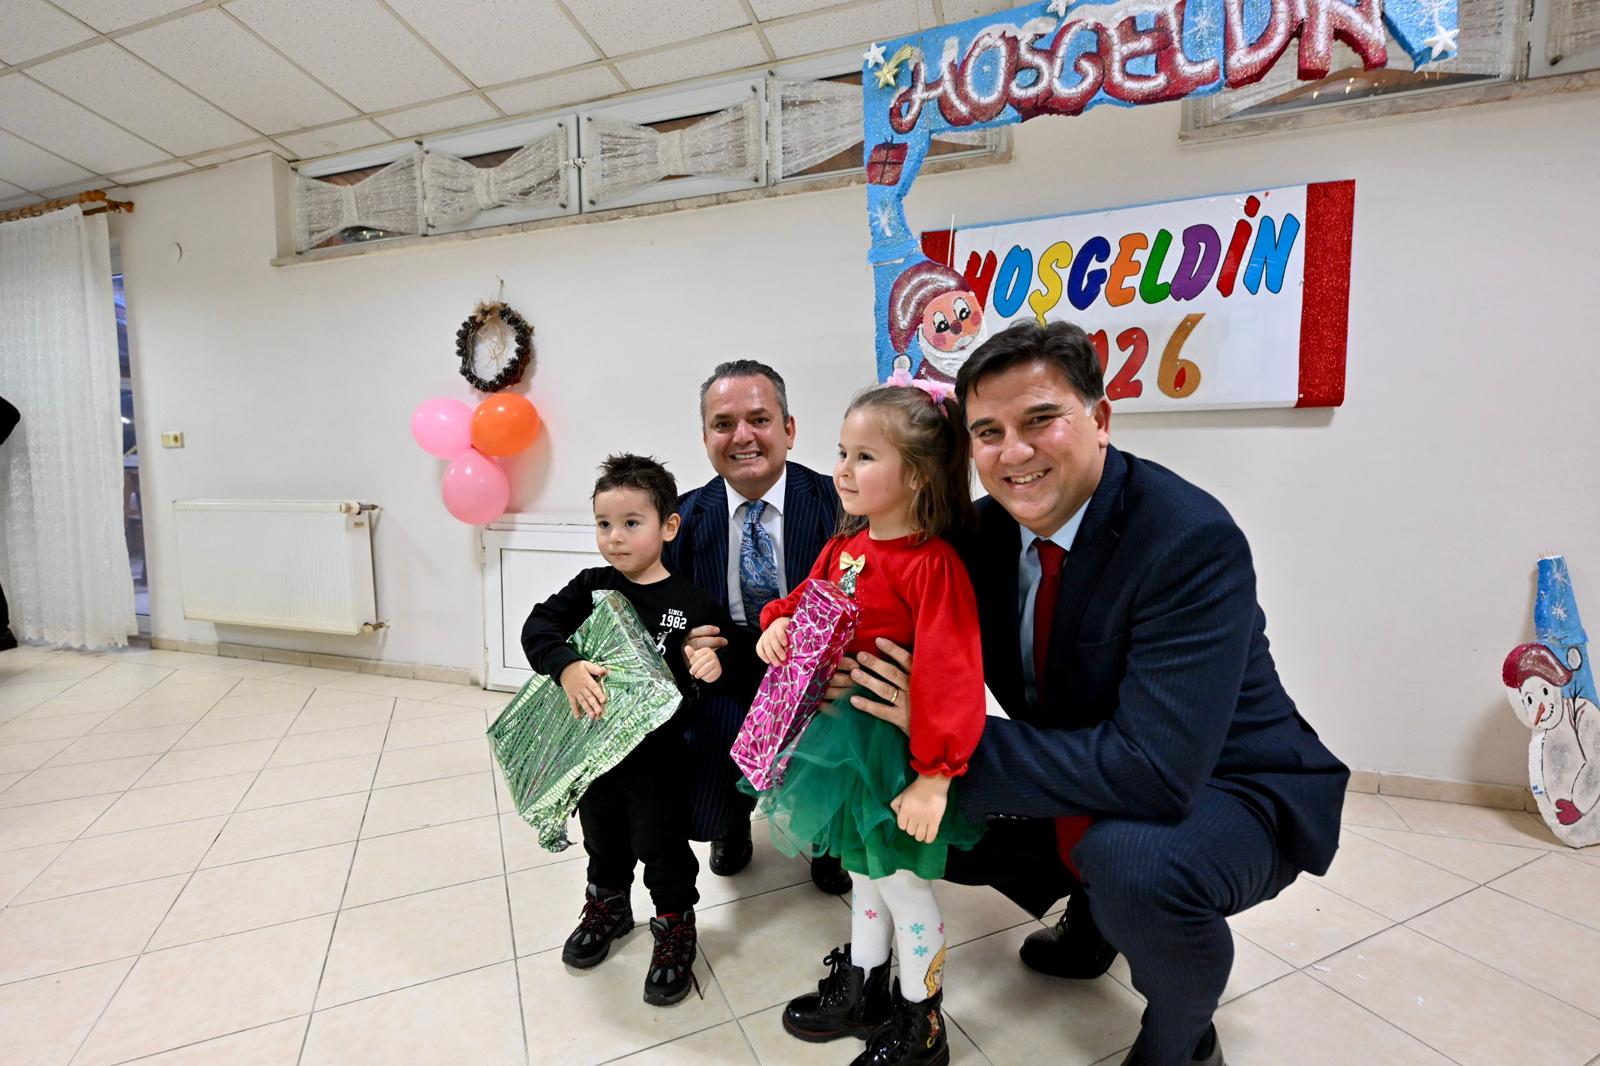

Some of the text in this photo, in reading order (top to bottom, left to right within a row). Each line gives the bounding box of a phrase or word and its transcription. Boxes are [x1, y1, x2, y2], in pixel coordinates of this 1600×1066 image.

[888, 0, 1388, 134] HOSGELDN
[963, 195, 1301, 327] HOŞGELDİN
[1087, 312, 1206, 401] 26
[660, 614, 687, 629] 1982
[668, 608, 684, 616] SINCE
